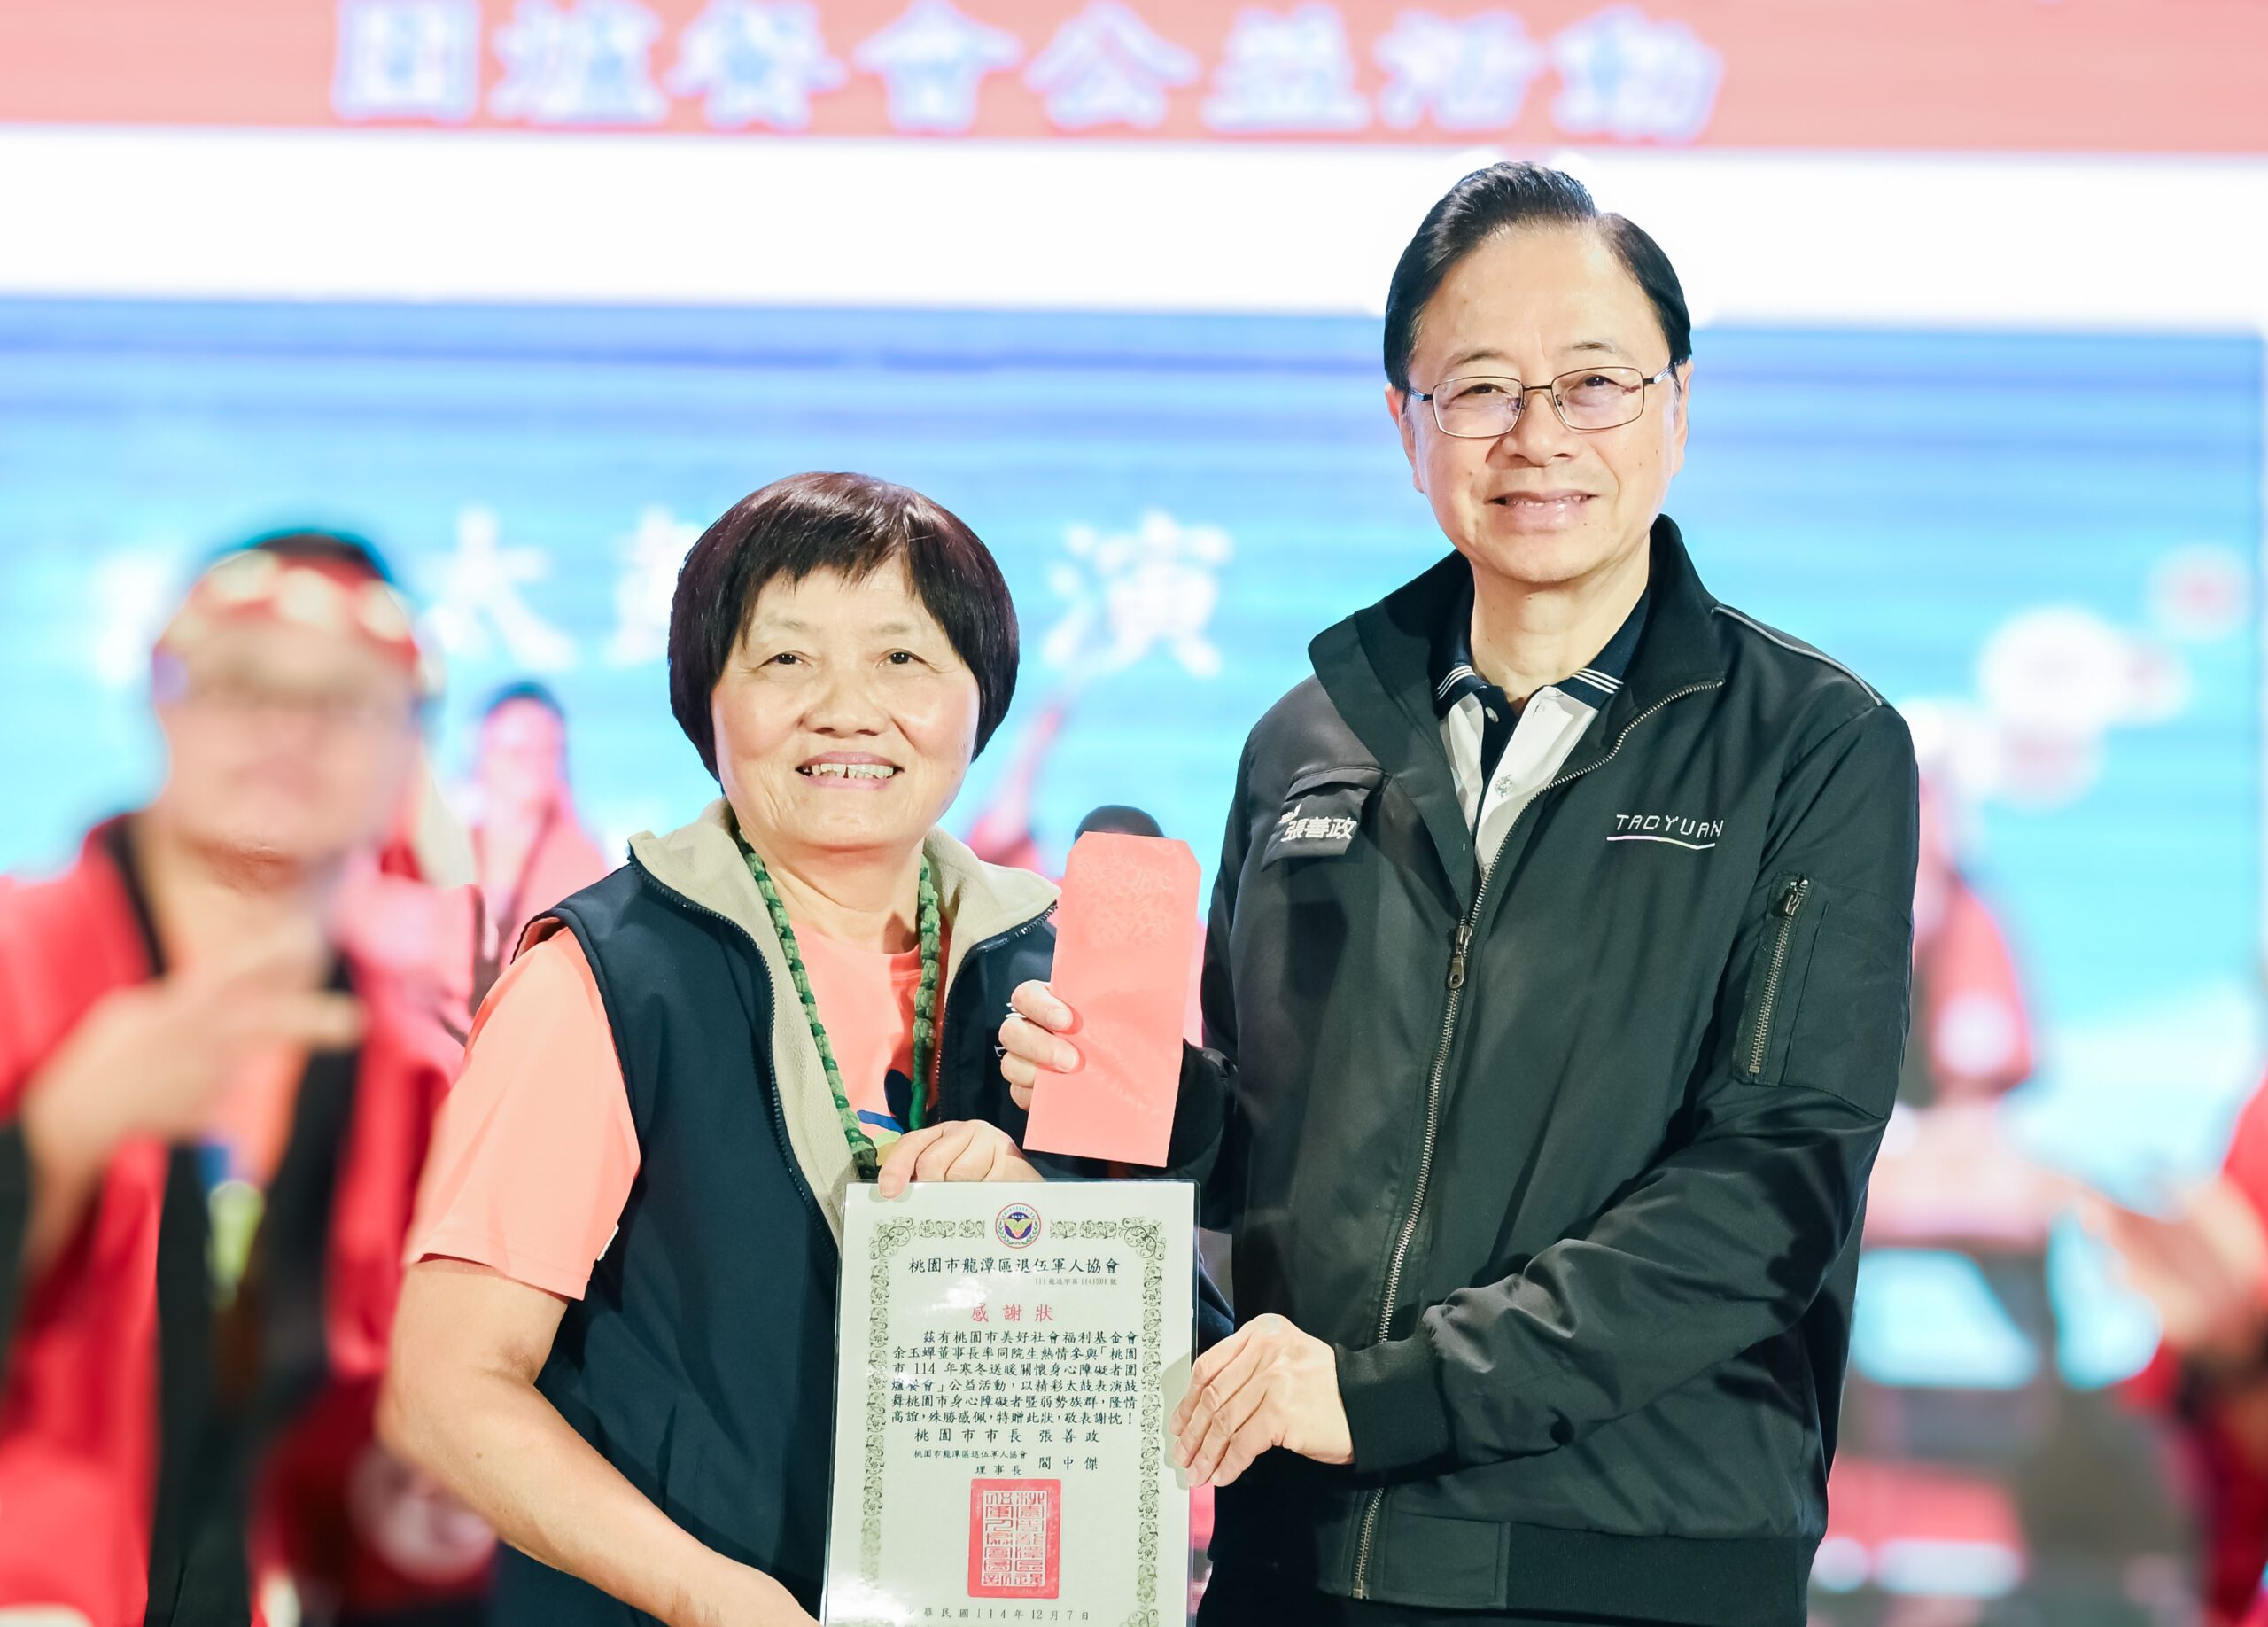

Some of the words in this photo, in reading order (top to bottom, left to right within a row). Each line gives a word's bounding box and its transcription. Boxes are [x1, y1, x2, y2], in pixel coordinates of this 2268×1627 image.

[1280, 816, 1358, 843] 張善政
[1616, 814, 1724, 838] TAOYUAN
[908, 1257, 1121, 1274] 桃園市龍潭區退伍軍人協會
[971, 1303, 1055, 1322] 感謝狀
[923, 1329, 1138, 1344] 茲有桃園市美好社會福利基金會
[913, 1428, 1022, 1444] 桃園市市長
[1038, 1428, 1100, 1444] 張善政
[913, 1449, 1028, 1460] 桃園市龍潭區退伍軍人協會
[975, 1464, 1022, 1476] 理事長
